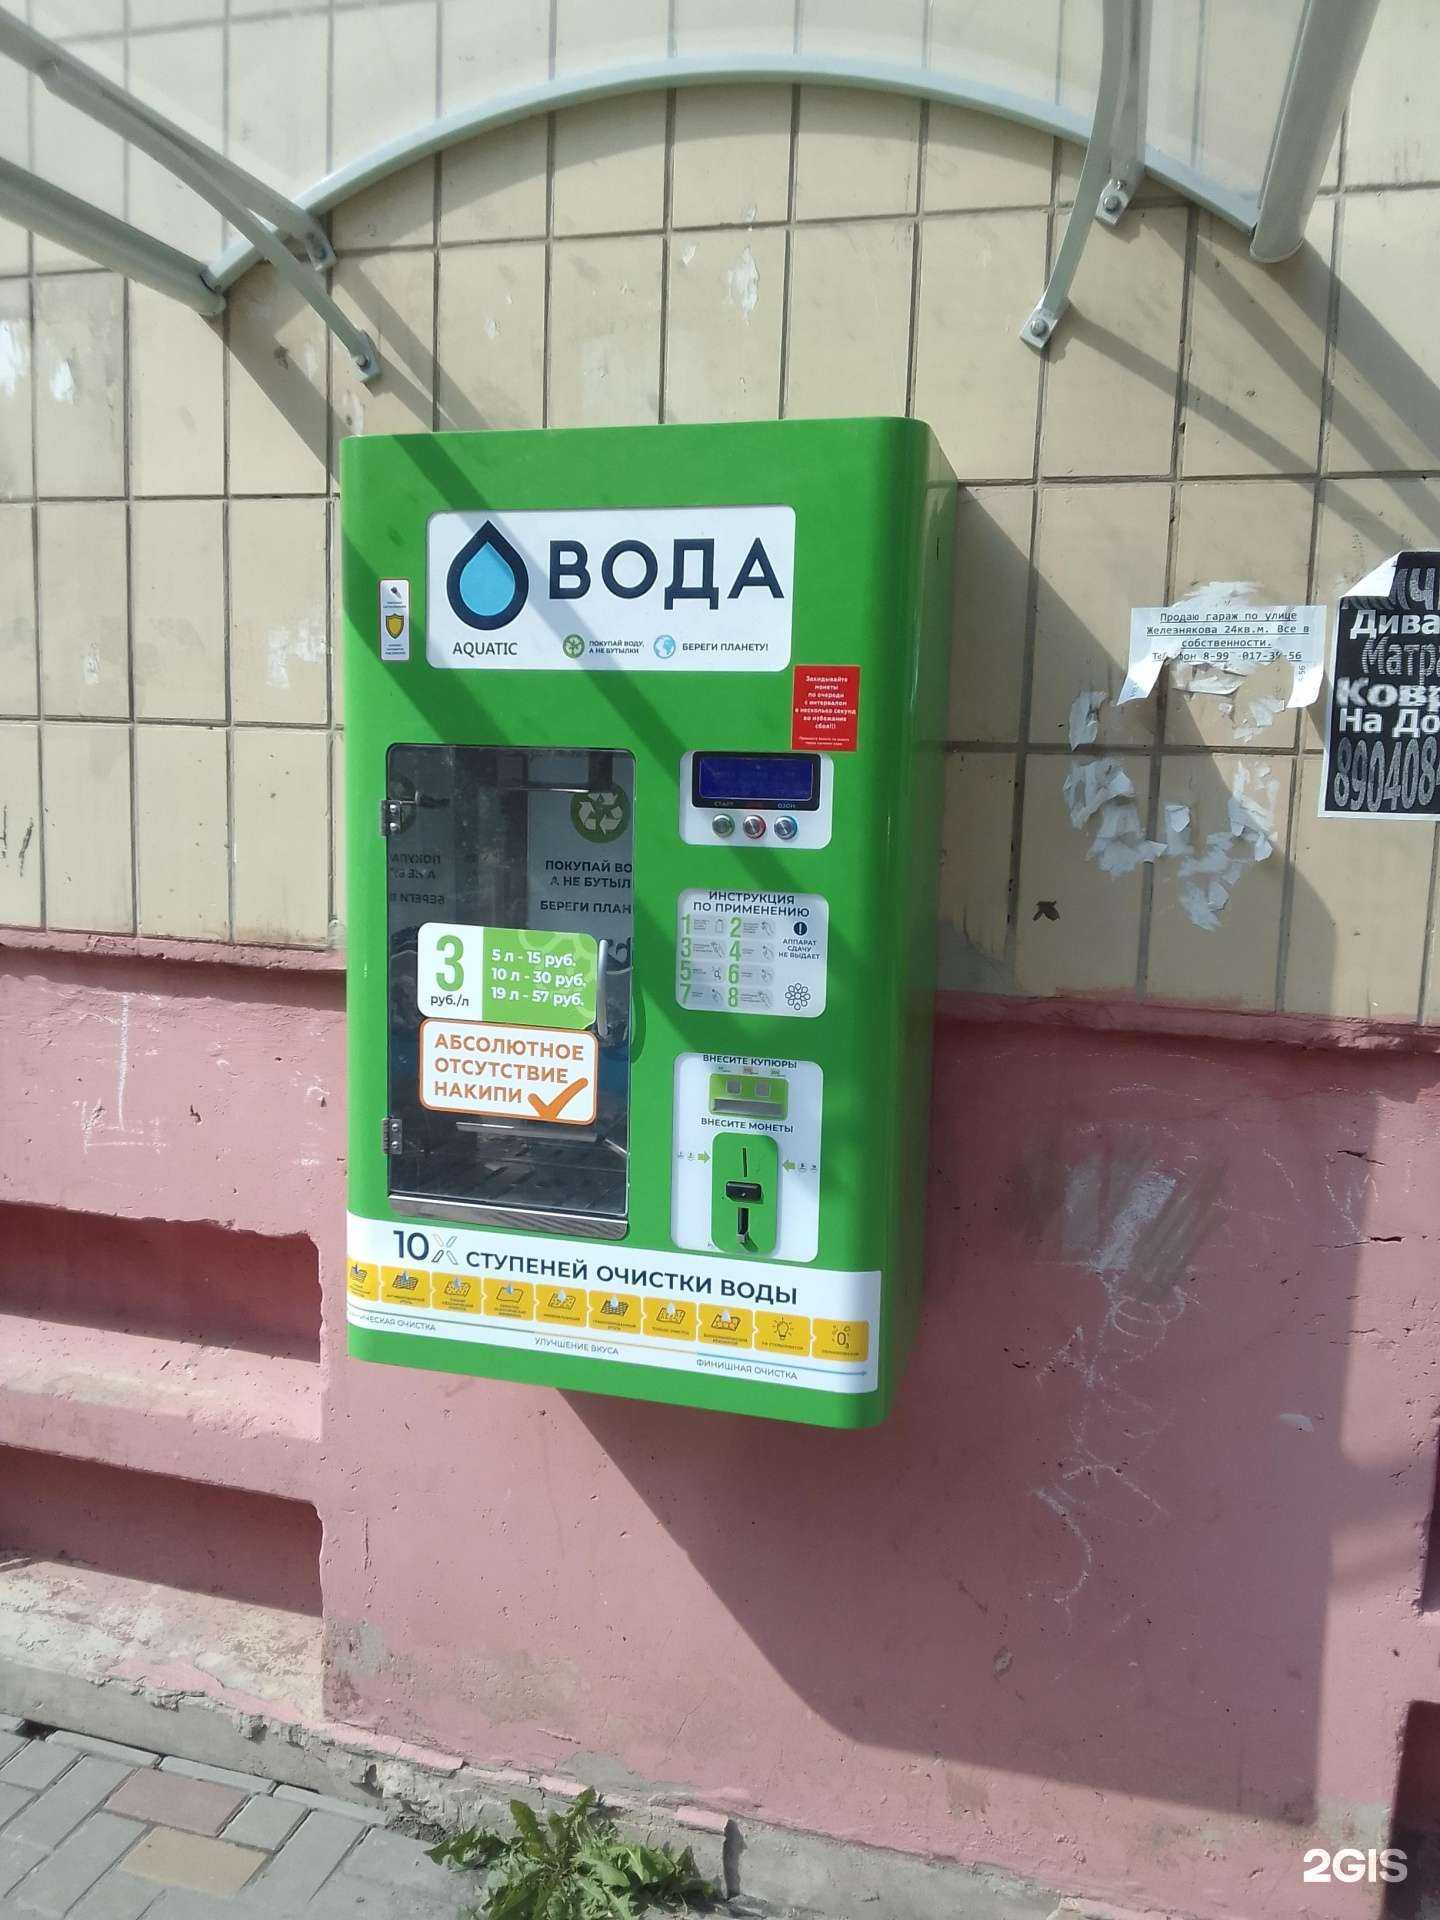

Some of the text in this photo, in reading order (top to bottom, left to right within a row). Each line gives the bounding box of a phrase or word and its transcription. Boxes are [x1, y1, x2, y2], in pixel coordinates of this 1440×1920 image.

[549, 538, 784, 610] ВОДА
[1160, 613, 1199, 622] Продаю
[1206, 613, 1238, 622] гараж
[1265, 612, 1297, 621] улице
[1350, 610, 1440, 640] Дива
[1147, 626, 1217, 634] Железнякова
[1277, 625, 1296, 633] Все
[453, 642, 517, 657] AQUATIC
[682, 643, 768, 652] БЕРЕГИ ПЛАНЕТУ!
[1182, 638, 1271, 648] собственности.
[1152, 651, 1197, 660] Тефон
[1361, 637, 1440, 685] Матр
[806, 675, 848, 683] Закидывайте
[1339, 708, 1440, 738] На До
[1333, 735, 1440, 812] 890408
[545, 859, 611, 872] ПОКУПАЙ
[563, 876, 580, 886] НЕ
[540, 900, 589, 912] БЕРЕГИ
[709, 891, 795, 905] ИНСТРУКЦИЯ
[693, 902, 810, 918] ПО ПРИМЕНЕНИЮ
[681, 914, 690, 935] 1
[730, 917, 742, 938] 2
[681, 937, 692, 958] 3
[729, 940, 741, 962] 4
[782, 938, 818, 946] АППАРАТ
[435, 934, 464, 992] 3
[491, 949, 500, 962] 5
[504, 952, 514, 963] л
[527, 951, 541, 964] 15
[545, 952, 576, 968] руб.
[789, 952, 820, 960] ВЫДАЕТ
[491, 967, 507, 981] 10
[509, 971, 520, 982] л
[533, 971, 551, 984] 30
[555, 973, 586, 988] руб.
[680, 960, 691, 981] 5
[728, 964, 740, 984] 6
[430, 994, 469, 1008] руб./л
[491, 987, 505, 1000] 19
[509, 991, 519, 1001] л
[531, 990, 549, 1003] 57
[553, 992, 584, 1007] руб.
[680, 984, 691, 1003] 7
[728, 987, 739, 1008] 8
[435, 1033, 584, 1061] АБСОЛЮТНОЕ
[434, 1057, 568, 1084] ОТСУТСТВИЕ
[703, 1054, 797, 1069] ВНЕСИТЕ КУПЮРЫ
[434, 1081, 522, 1103] НАКИПИ
[701, 1117, 793, 1133] ВНЕСИТЕ МОНЕТЫ
[466, 1251, 588, 1280] СТУПЕНЕЙ
[596, 1265, 712, 1294] ОЧИСТКИ
[720, 1279, 797, 1305] ВОДЫ
[534, 1337, 619, 1355] УЛУЧШЕНИЕ ВКУСА
[696, 1359, 798, 1380] ФИНИШНАЯ ОЧИСТКА
